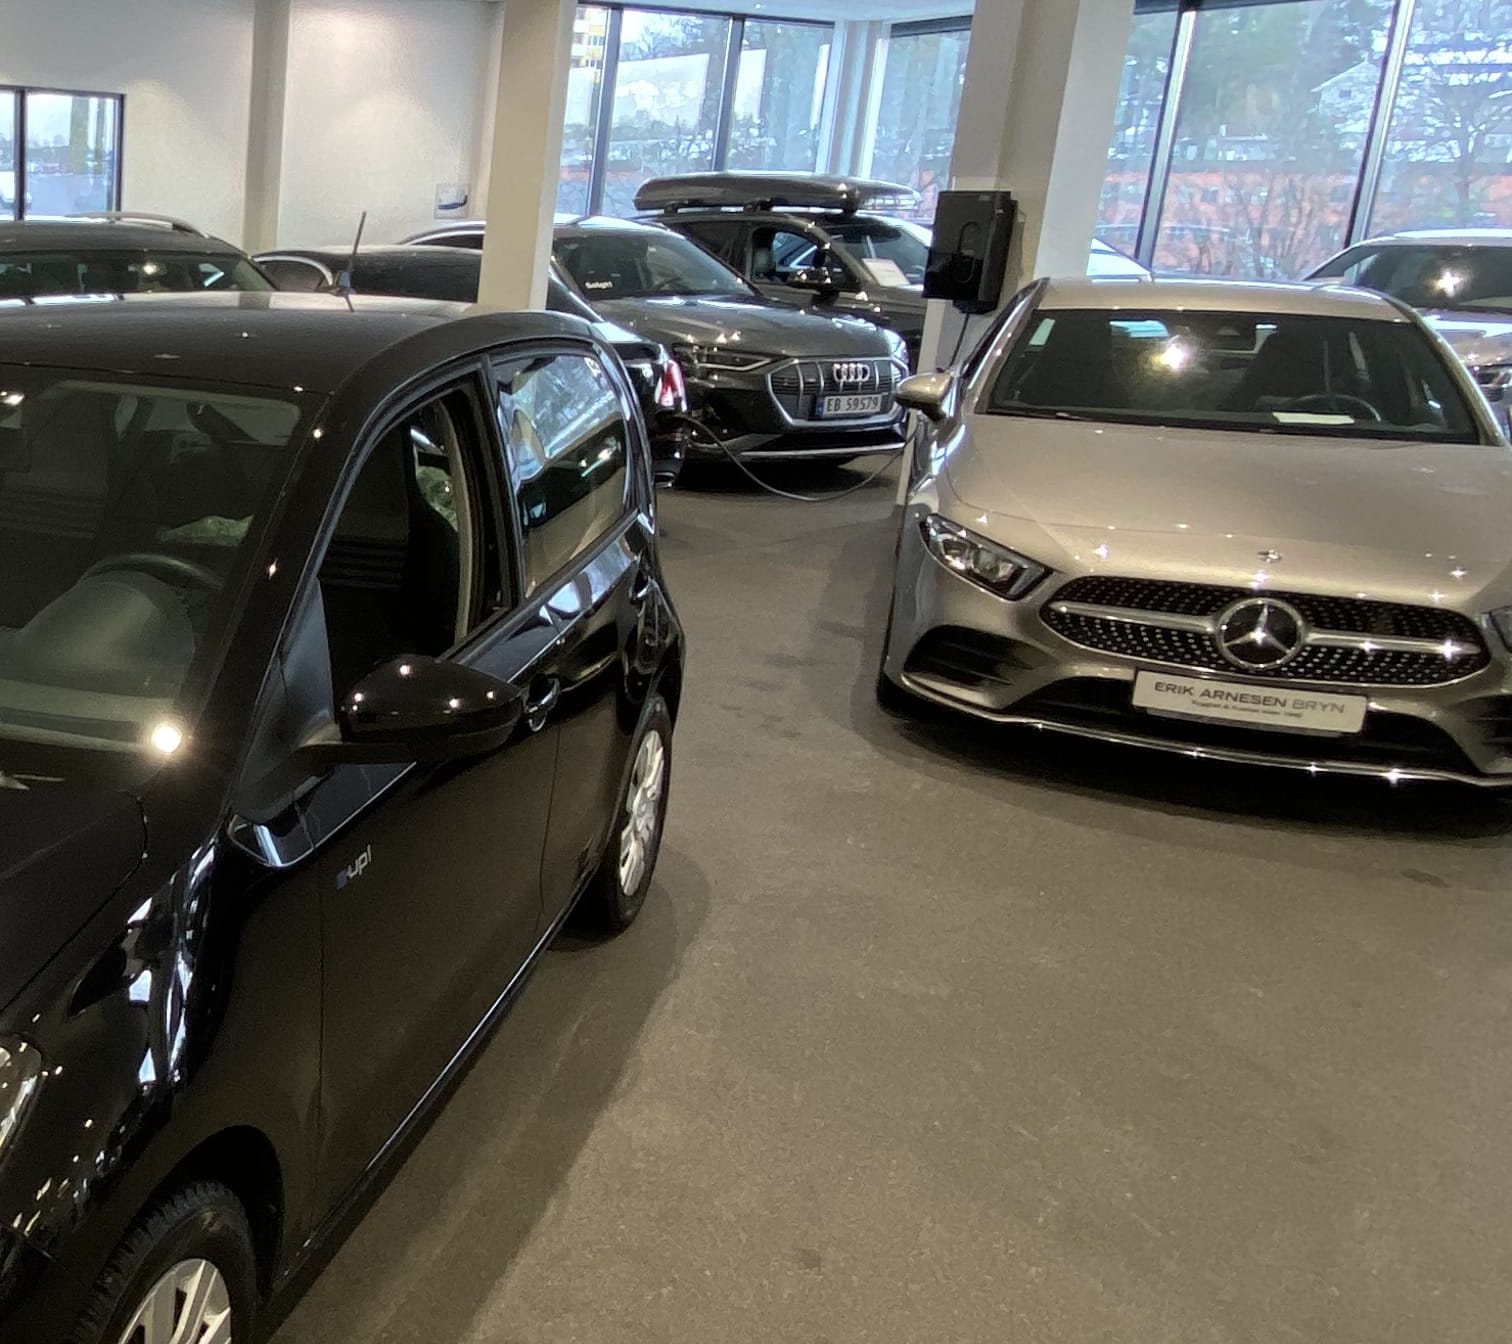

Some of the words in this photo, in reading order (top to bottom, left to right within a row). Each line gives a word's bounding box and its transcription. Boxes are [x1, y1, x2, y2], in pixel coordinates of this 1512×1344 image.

[826, 398, 841, 412] EB
[1155, 682, 1194, 696] ERIK
[1199, 688, 1287, 707] ARNESEN
[1292, 699, 1345, 714] BRYN
